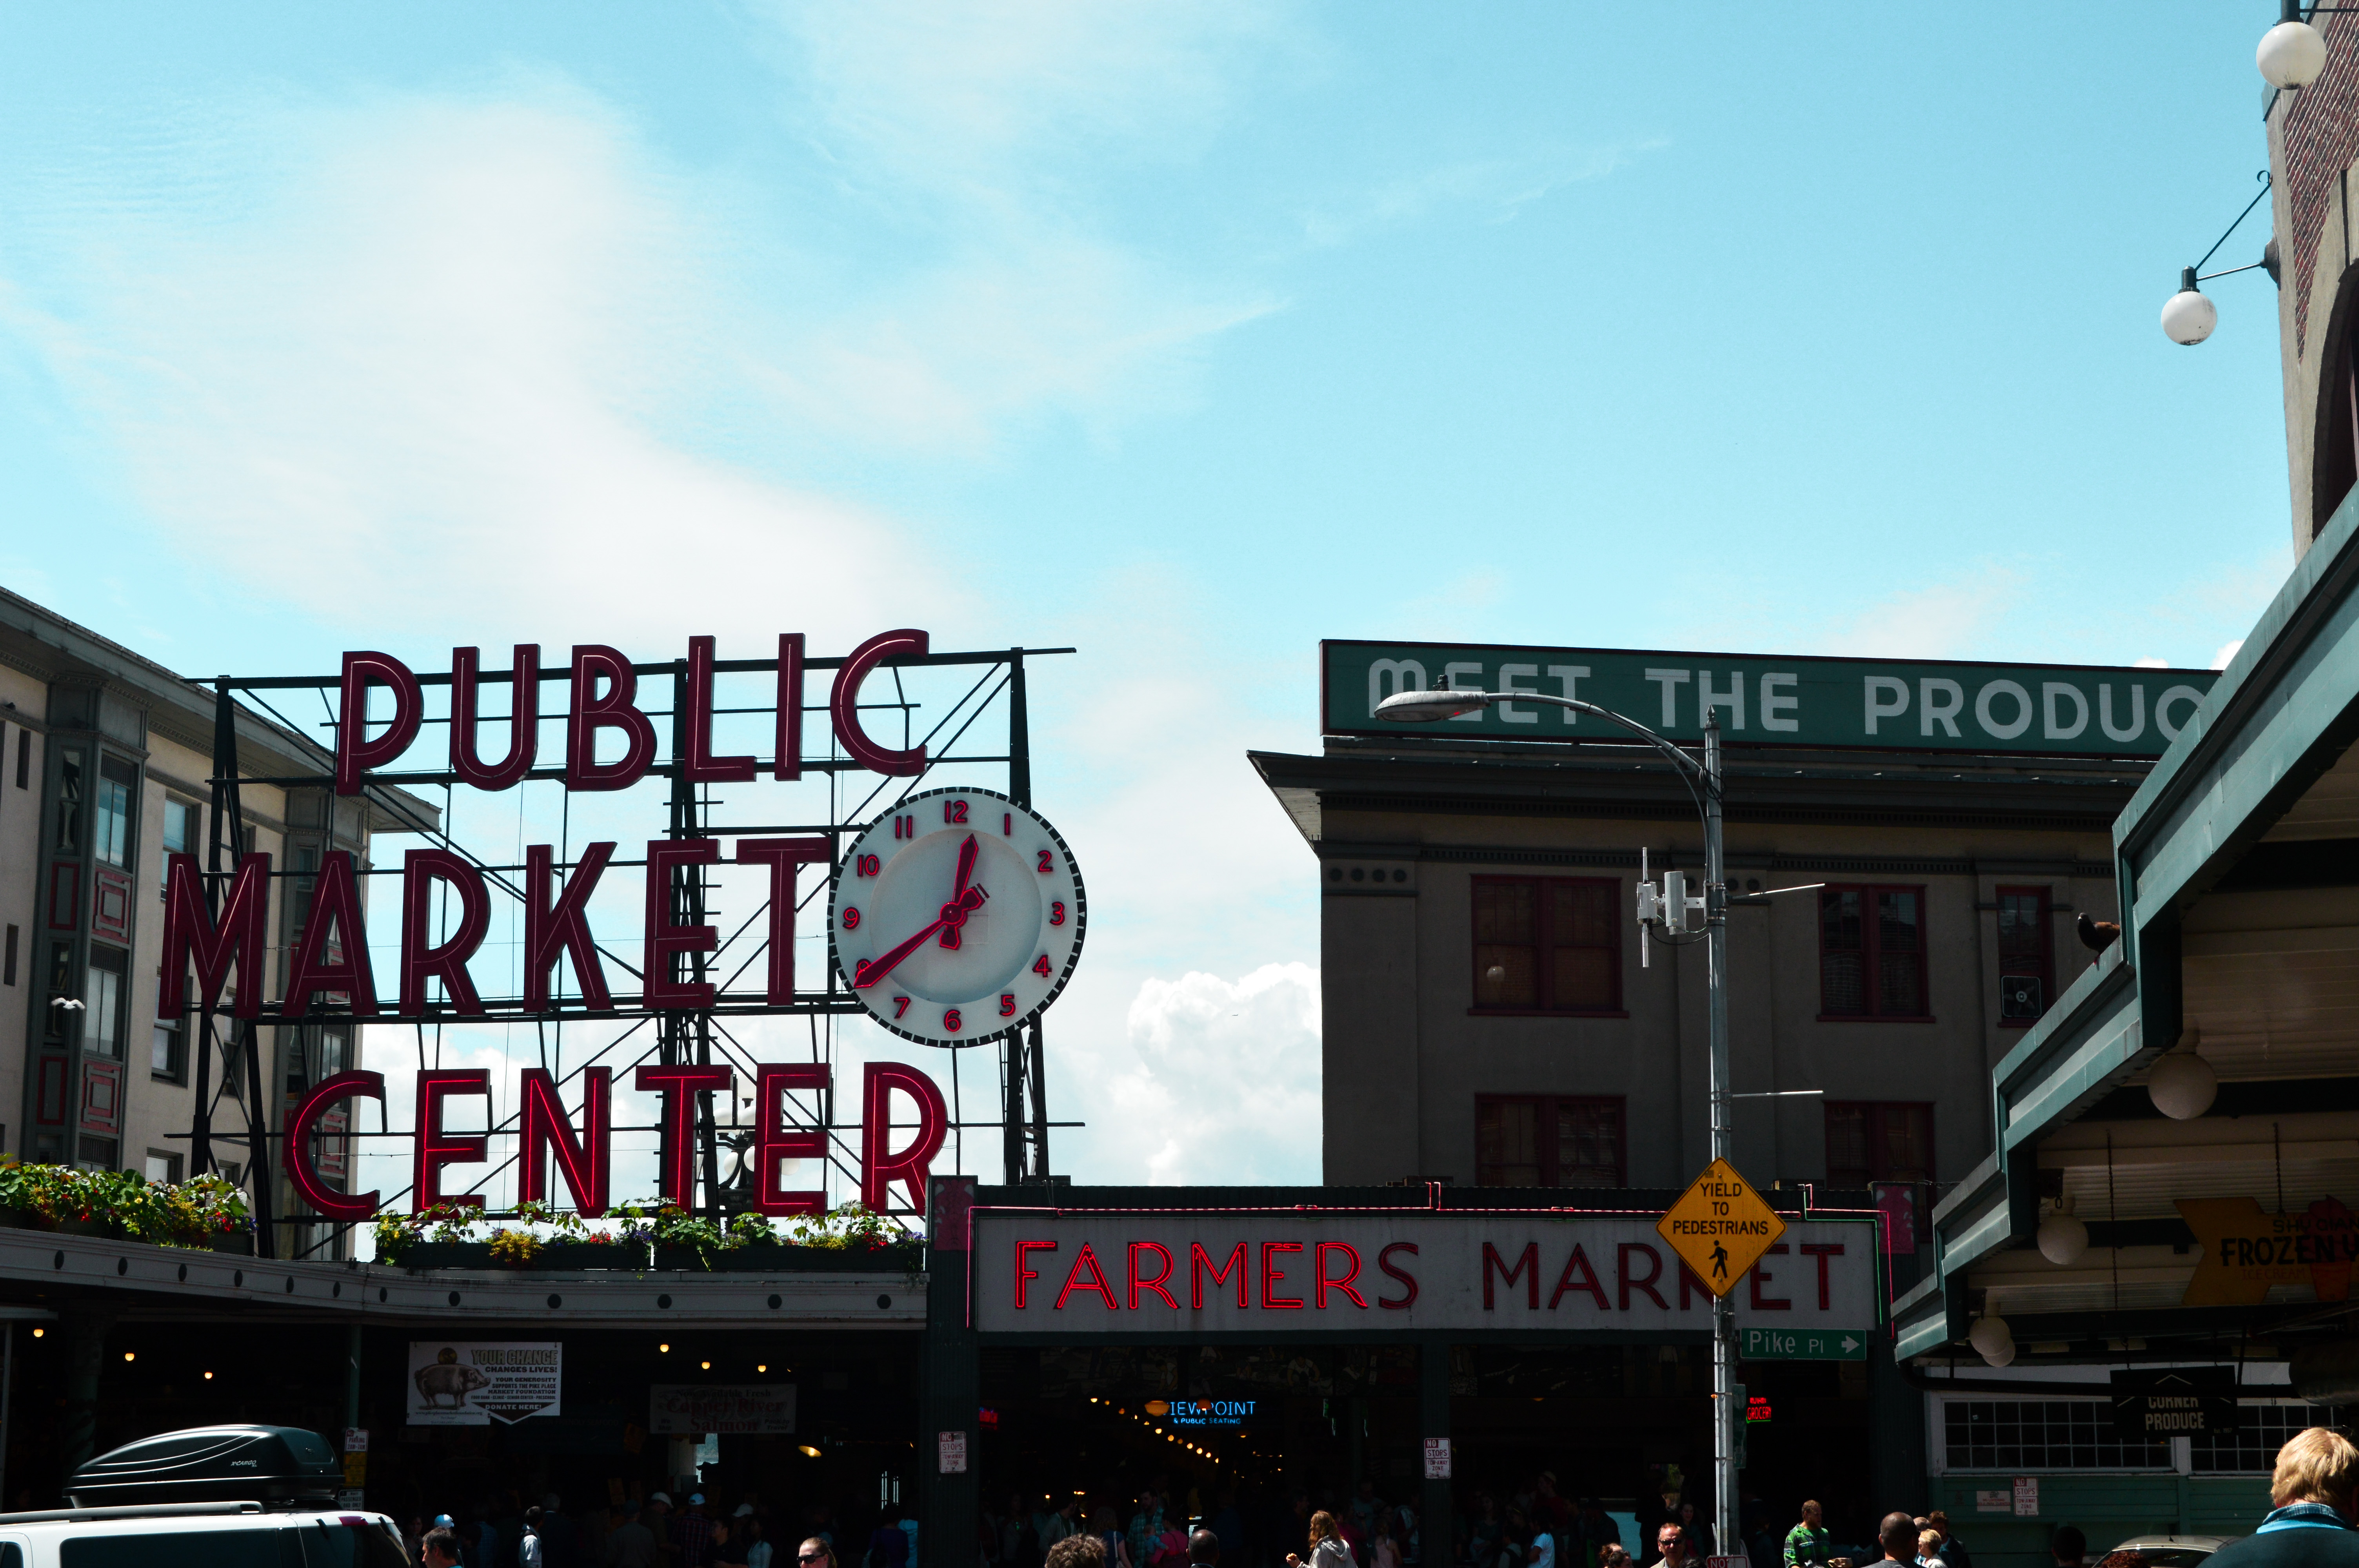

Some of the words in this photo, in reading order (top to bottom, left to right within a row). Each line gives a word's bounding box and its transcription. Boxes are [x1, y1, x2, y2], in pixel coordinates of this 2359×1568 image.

[1369, 658, 1591, 725] MEET
[1645, 668, 1798, 731] THE
[336, 628, 929, 796] PUBLIC
[944, 800, 969, 823] 12
[895, 815, 913, 839] 11
[1004, 813, 1011, 835] 1
[857, 854, 880, 877] 10
[1037, 850, 1054, 873] 2
[842, 907, 861, 930] 9
[1049, 902, 1065, 926] 3
[159, 836, 832, 1020] MARKET
[1032, 955, 1052, 978] 4
[893, 996, 912, 1019] 7
[999, 994, 1016, 1017] 5
[943, 1009, 962, 1033] 6
[282, 1062, 949, 1221] CENTER
[1700, 1183, 1742, 1197] YIELD
[1712, 1202, 1729, 1216] TO
[1673, 1221, 1768, 1235] PEDESTRIANS
[2273, 1219, 2311, 1233] SHY
[2220, 1235, 2335, 1266] FROZEN
[1015, 1241, 1419, 1310] FARMERS
[1483, 1242, 1845, 1310] MARKET
[1750, 1330, 1796, 1354] Pike
[1809, 1339, 1823, 1353] Pl
[471, 1350, 506, 1365] YOUR
[507, 1350, 558, 1365] CHANGE
[667, 1398, 731, 1417] Copper
[738, 1398, 784, 1412] River
[1747, 1406, 1771, 1420] GROCERY
[690, 1417, 758, 1432] Salmon
[2145, 1412, 2205, 1430] PRODUCE
[1710, 1558, 1725, 1568] NO
